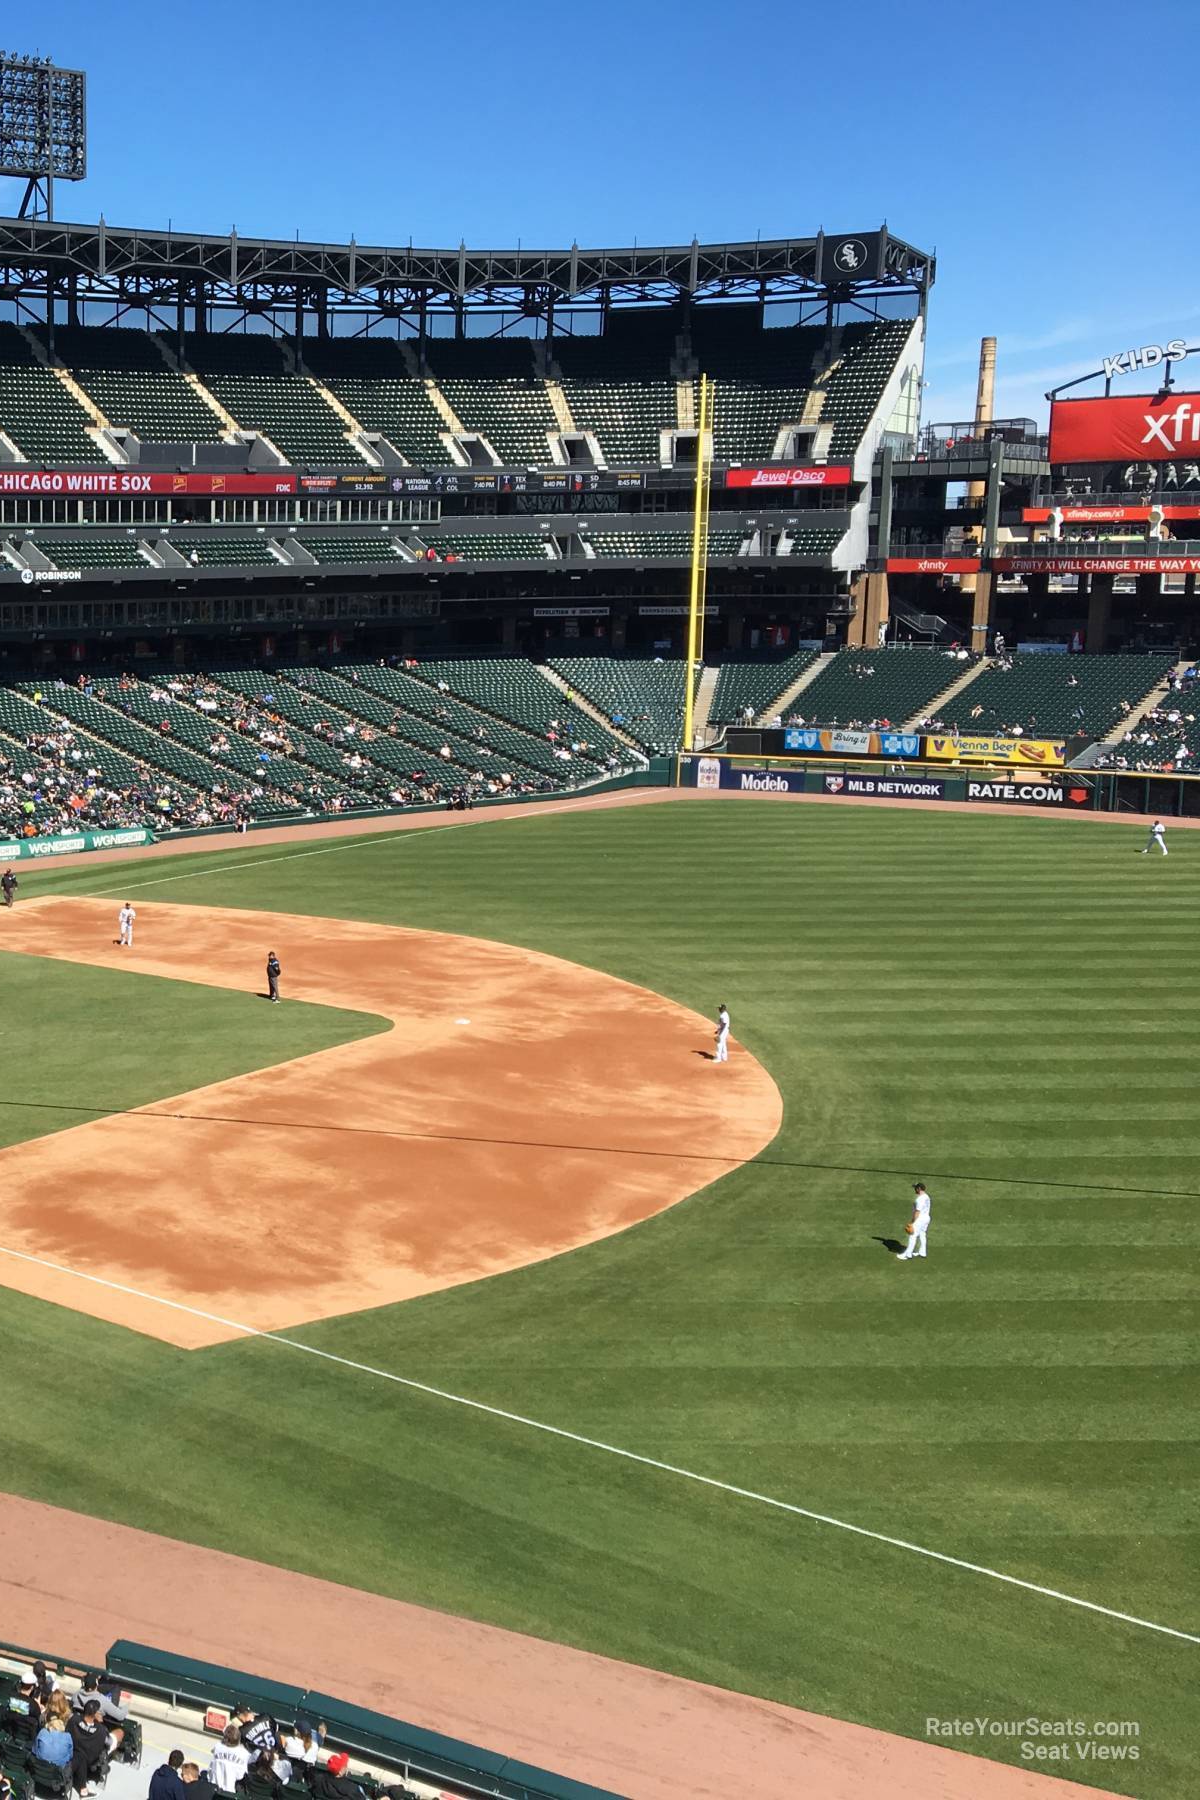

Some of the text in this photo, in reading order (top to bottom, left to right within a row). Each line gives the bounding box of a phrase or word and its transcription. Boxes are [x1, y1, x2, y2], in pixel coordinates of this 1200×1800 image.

[1102, 339, 1188, 379] KIDS
[66, 475, 117, 491] WHITE
[121, 476, 152, 491] SOX
[276, 484, 291, 493] FDIC
[1067, 509, 1125, 518] xfinity.com/x1
[918, 560, 948, 570] xfinity
[1011, 561, 1043, 569] XFINITY
[1045, 561, 1056, 569] X1
[1058, 561, 1082, 569] WILL
[1084, 560, 1131, 570] CHANGE
[1133, 560, 1156, 570] THE
[1159, 560, 1187, 570] WAY
[22, 571, 82, 581] 42 ROBINSON
[834, 732, 868, 745] Bring it
[951, 739, 1017, 752] Vienna Beef
[741, 773, 789, 792] Modelo
[848, 780, 941, 795] MLB NETWORK
[968, 782, 1064, 802] RATE.COM
[28, 841, 55, 854] WGN
[92, 834, 118, 848] WGN
[252, 1730, 276, 1751] 56
